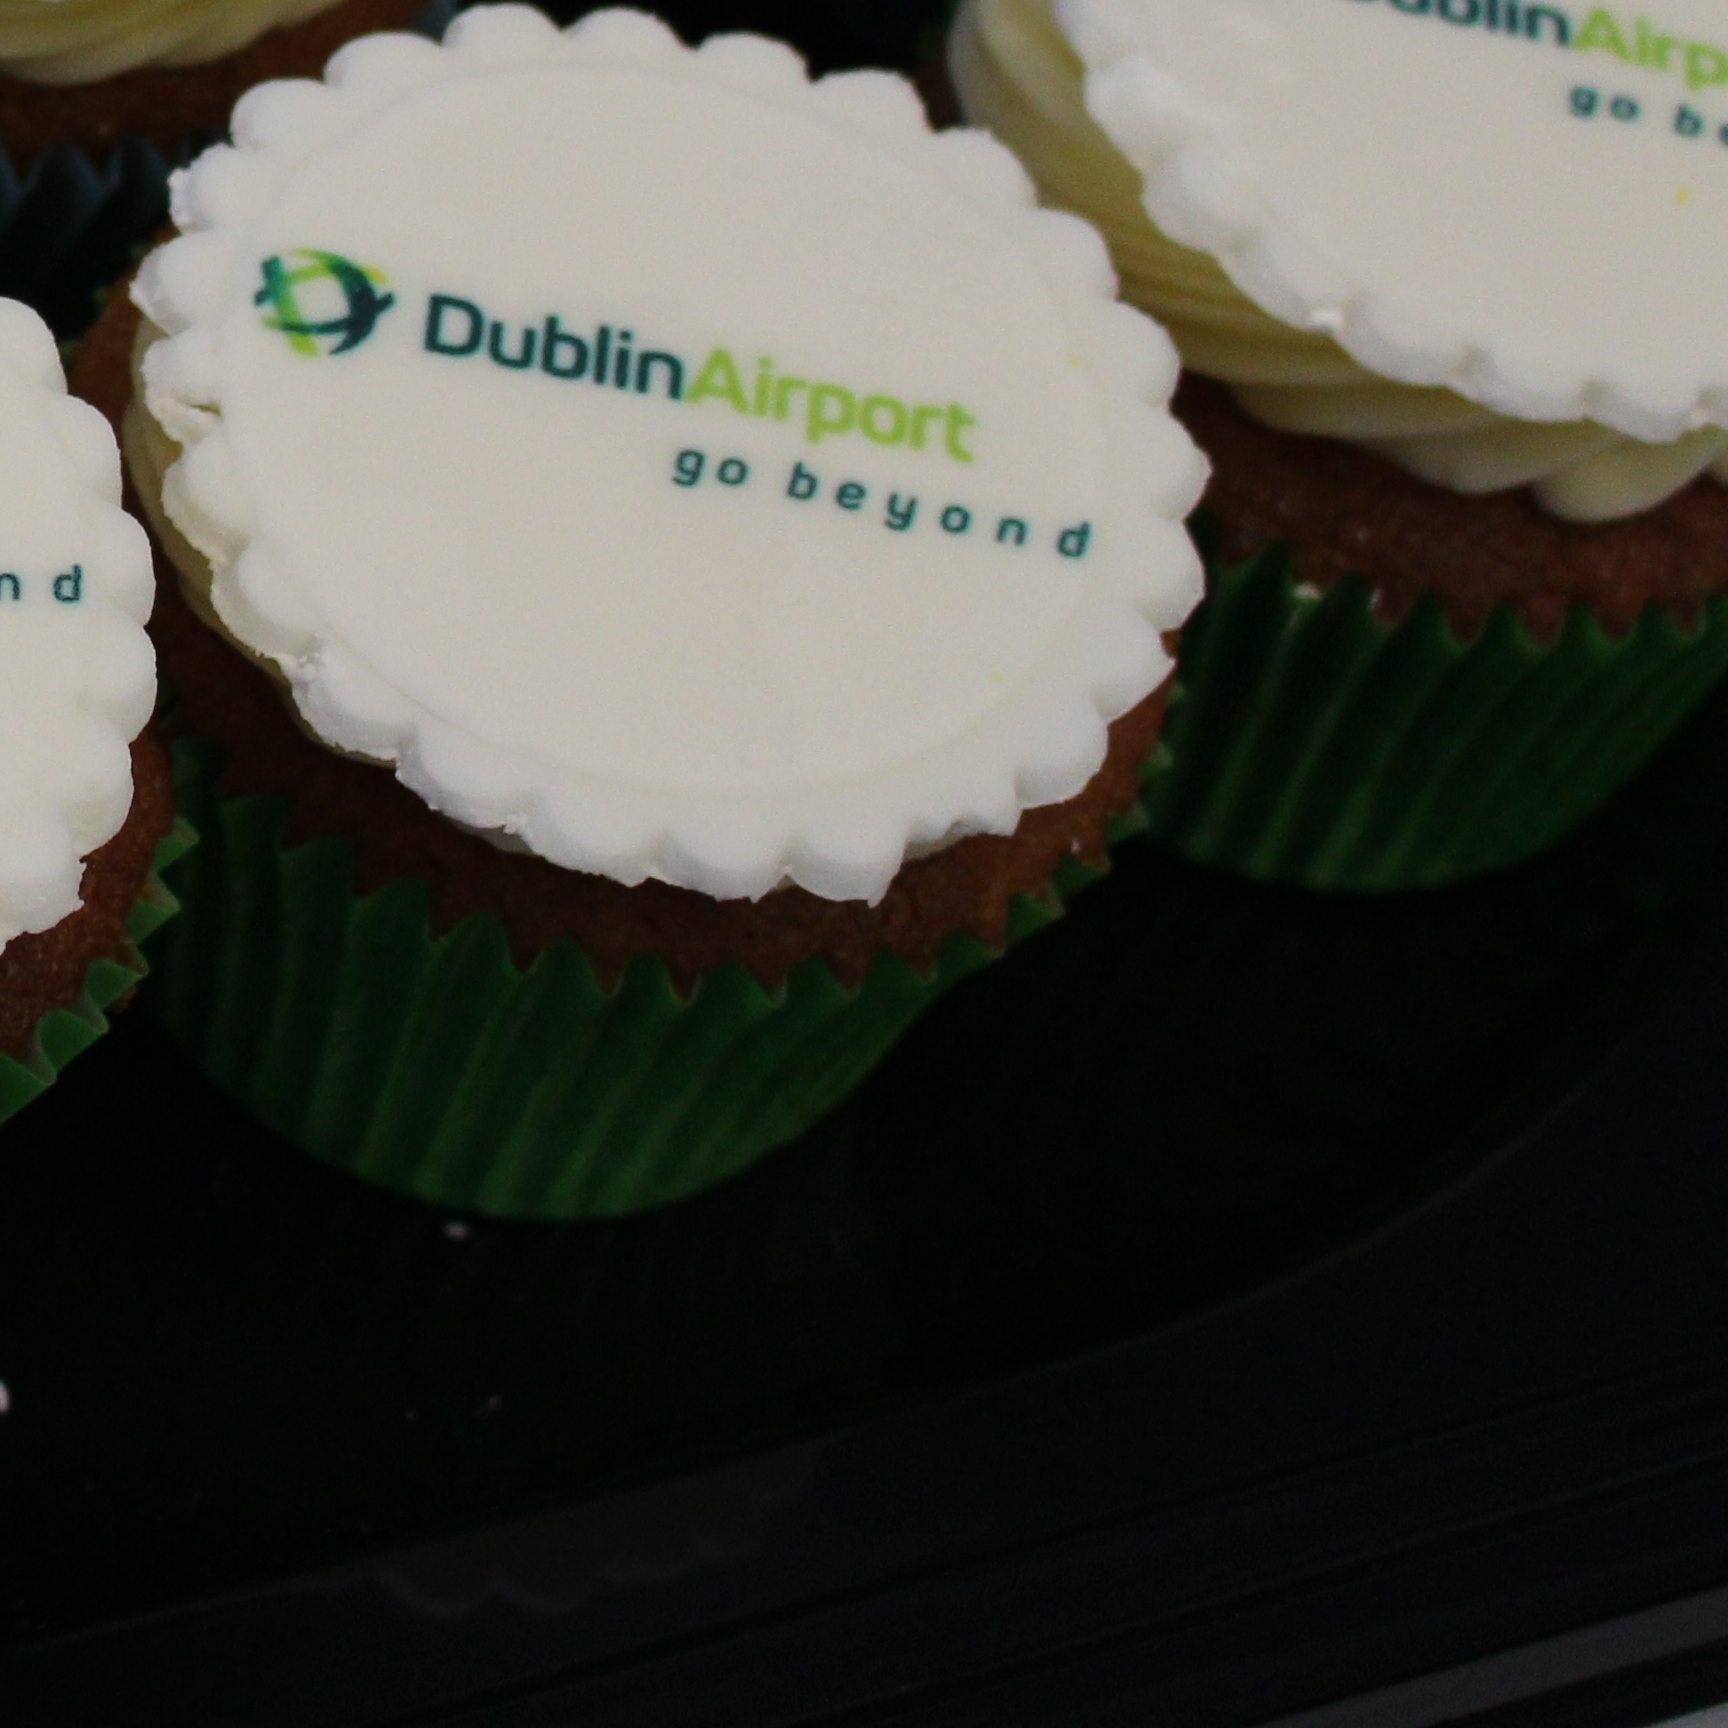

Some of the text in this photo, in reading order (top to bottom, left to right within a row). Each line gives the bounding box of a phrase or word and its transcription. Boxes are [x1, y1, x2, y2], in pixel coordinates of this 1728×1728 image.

[1568, 84, 1643, 123] go
[421, 291, 978, 465] DublinAirport
[671, 447, 1093, 562] go beyond
